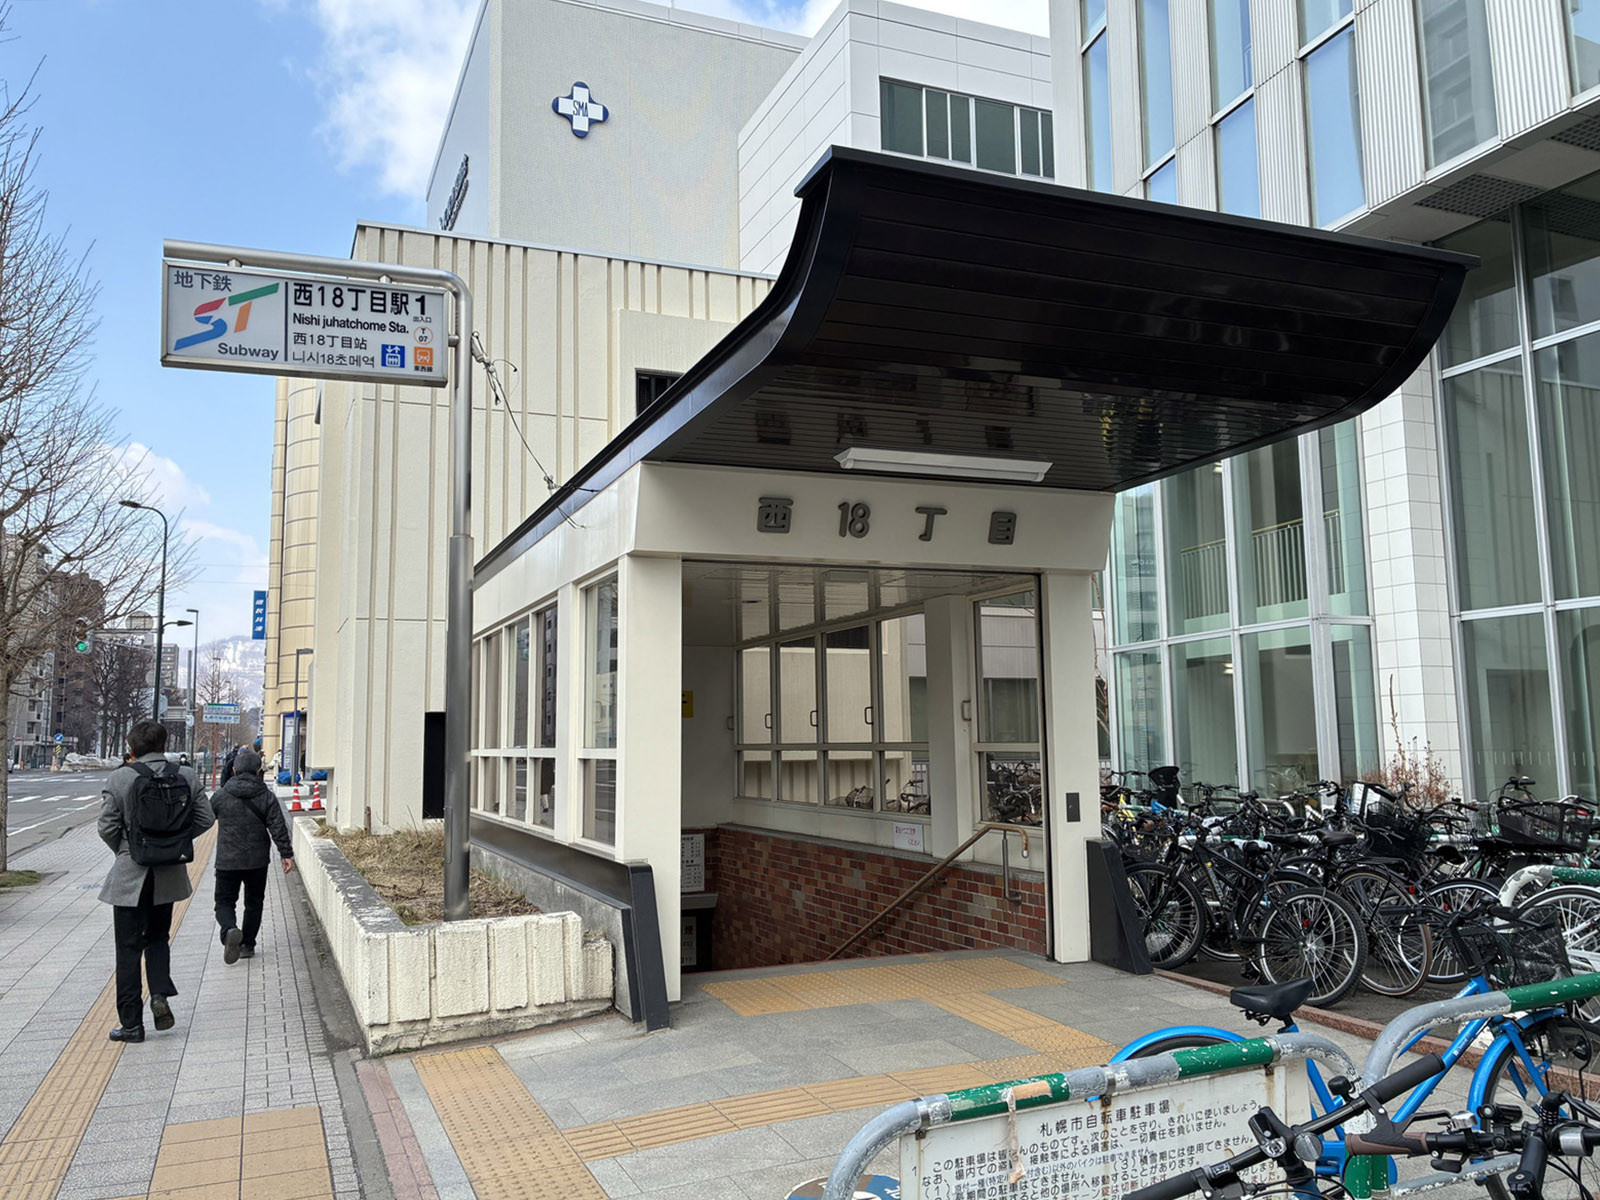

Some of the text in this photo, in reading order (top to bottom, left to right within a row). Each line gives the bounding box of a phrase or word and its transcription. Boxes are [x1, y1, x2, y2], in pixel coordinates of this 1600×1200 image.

[572, 100, 589, 118] SMA
[174, 270, 232, 293] 地下鉄
[293, 282, 410, 317] 西18丁目駅
[292, 312, 410, 335] Nishi juhatchome Sta.
[412, 315, 432, 324] 出入口
[418, 335, 429, 343] 07
[420, 327, 426, 335] T
[292, 331, 368, 351] 西18丁目站
[217, 342, 280, 361] Subway
[292, 350, 376, 369] 니시18초메역
[413, 365, 433, 373] 東西線
[1039, 1099, 1171, 1138] 札幌市自転車駐車場
